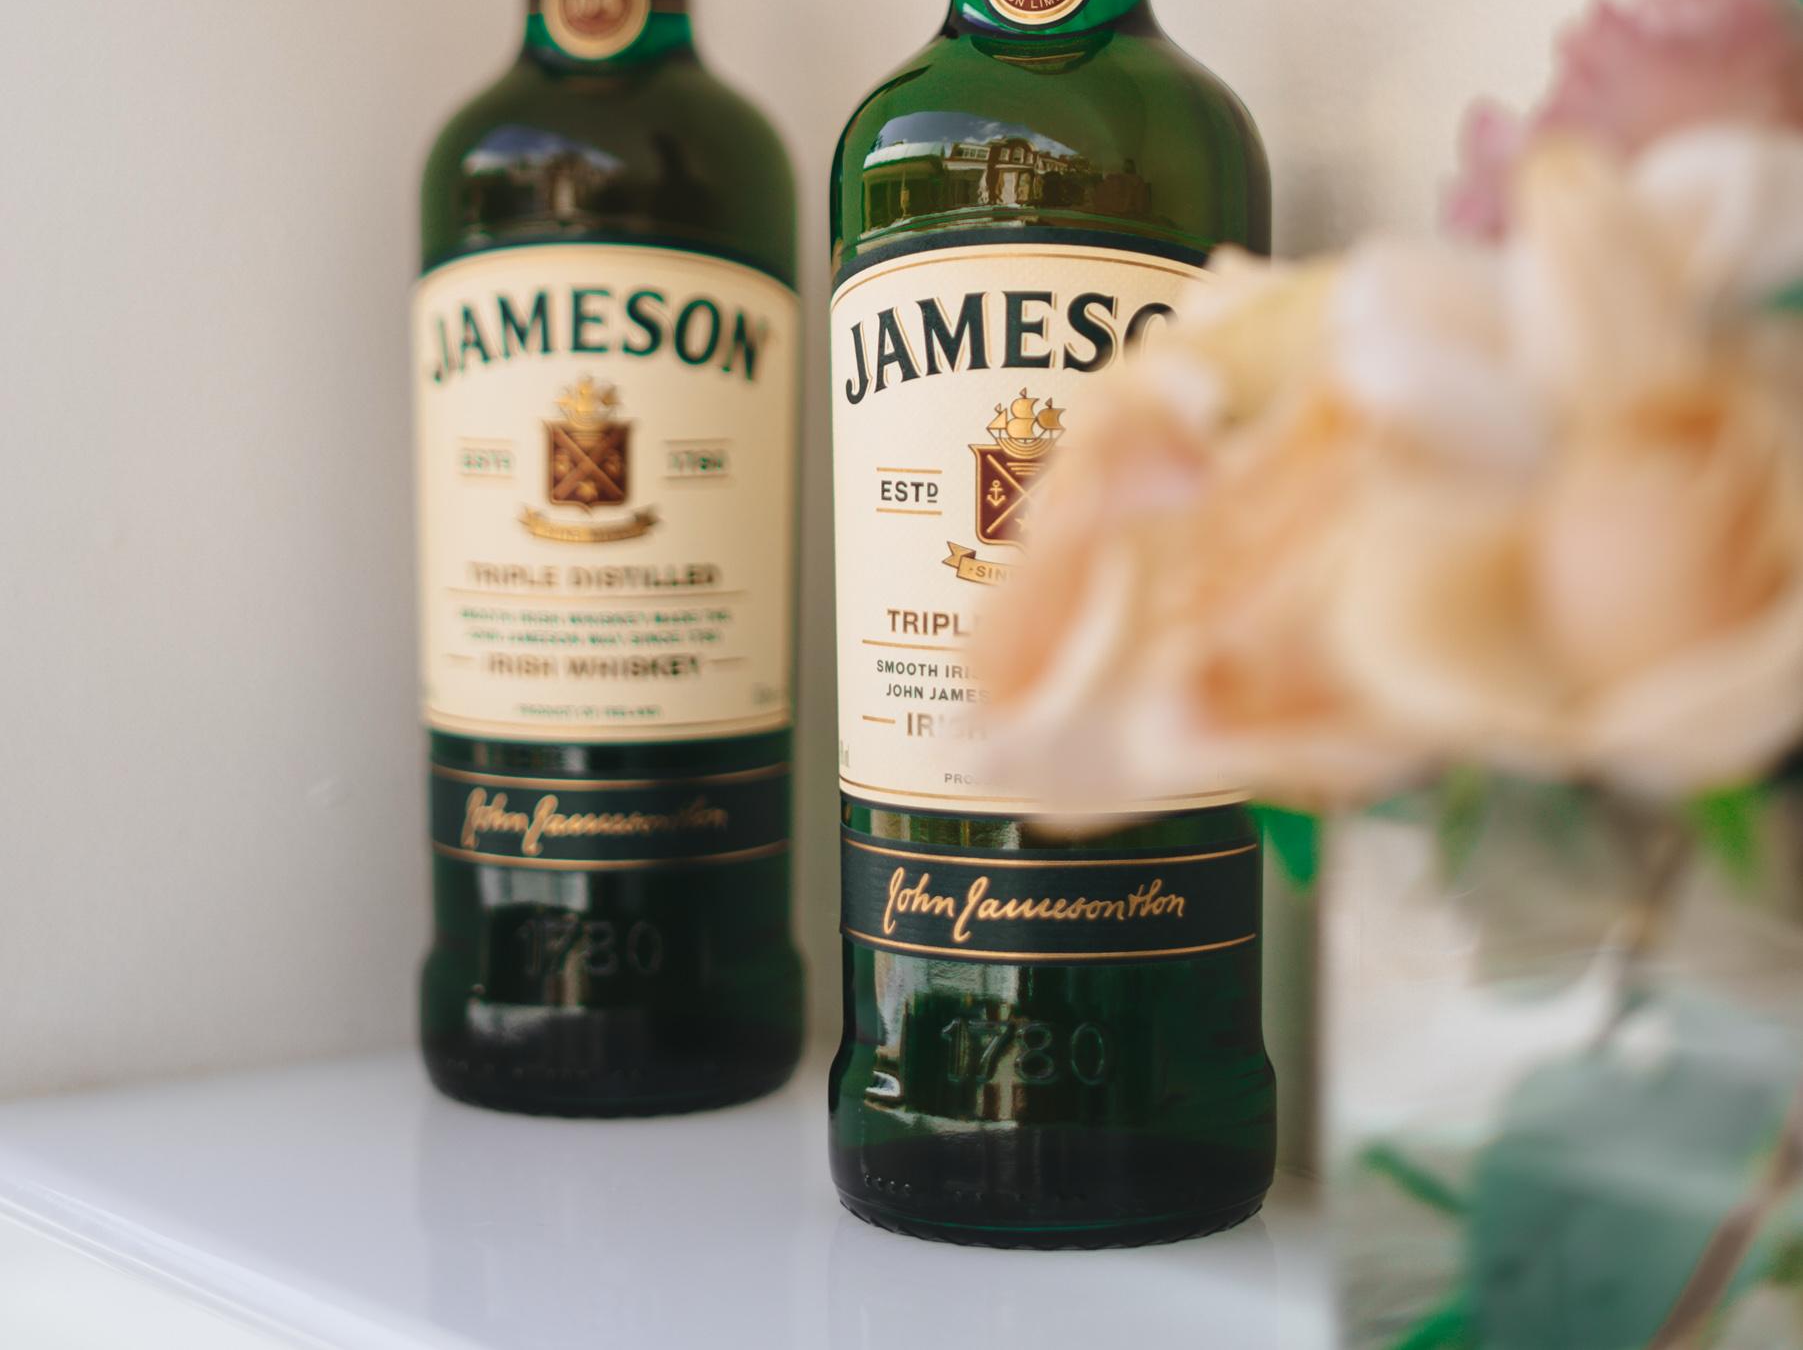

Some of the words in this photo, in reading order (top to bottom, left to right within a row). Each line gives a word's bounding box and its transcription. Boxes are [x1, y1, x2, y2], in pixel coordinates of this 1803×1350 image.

[433, 287, 770, 384] JAMESON
[880, 479, 939, 504] ESTD
[886, 608, 980, 637] TRIPL
[876, 659, 939, 677] SMOOTH
[886, 683, 924, 699] JOHN
[883, 865, 954, 934] John
